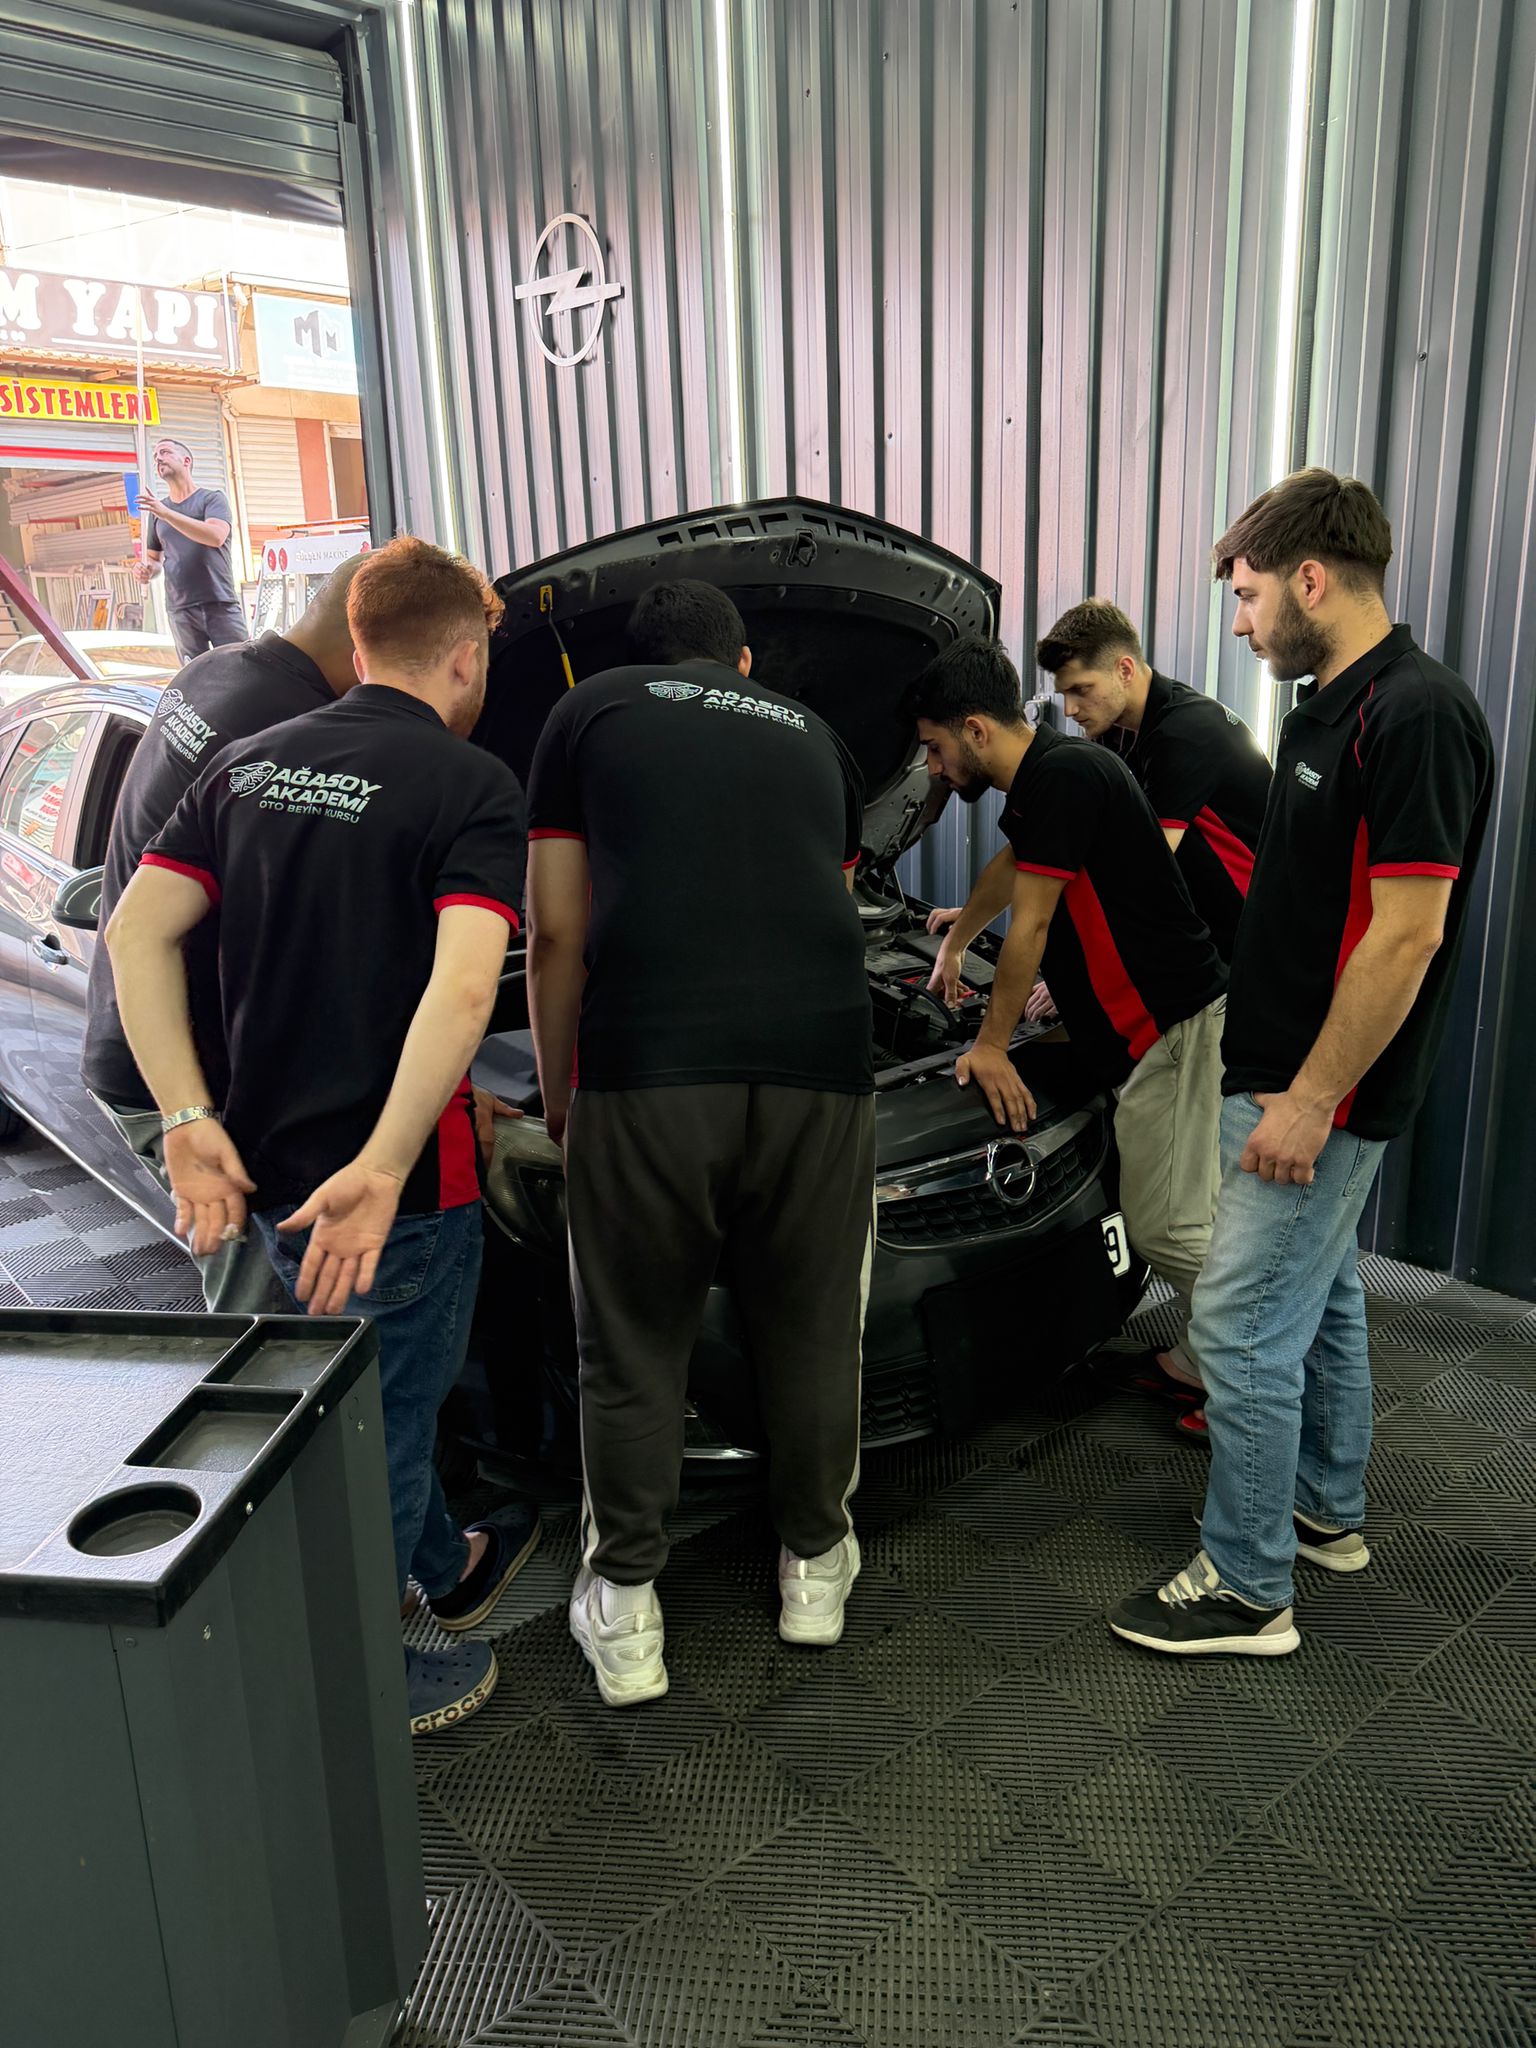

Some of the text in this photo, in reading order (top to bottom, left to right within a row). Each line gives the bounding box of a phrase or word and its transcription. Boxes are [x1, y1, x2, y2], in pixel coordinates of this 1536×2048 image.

[63, 278, 218, 349] YAPI
[0, 379, 153, 421] SİSTEMLERİ
[703, 703, 730, 712] OTO
[733, 707, 769, 720] BEYİN
[704, 689, 805, 719] AĞASOY
[165, 714, 208, 755] AKADEMİ
[174, 702, 218, 741] AĞASOY
[176, 742, 198, 763] KURSU
[270, 766, 383, 797] AĞASOY
[259, 800, 360, 824] OTO BEYİN KURSU
[262, 784, 371, 813] AKADEMİ
